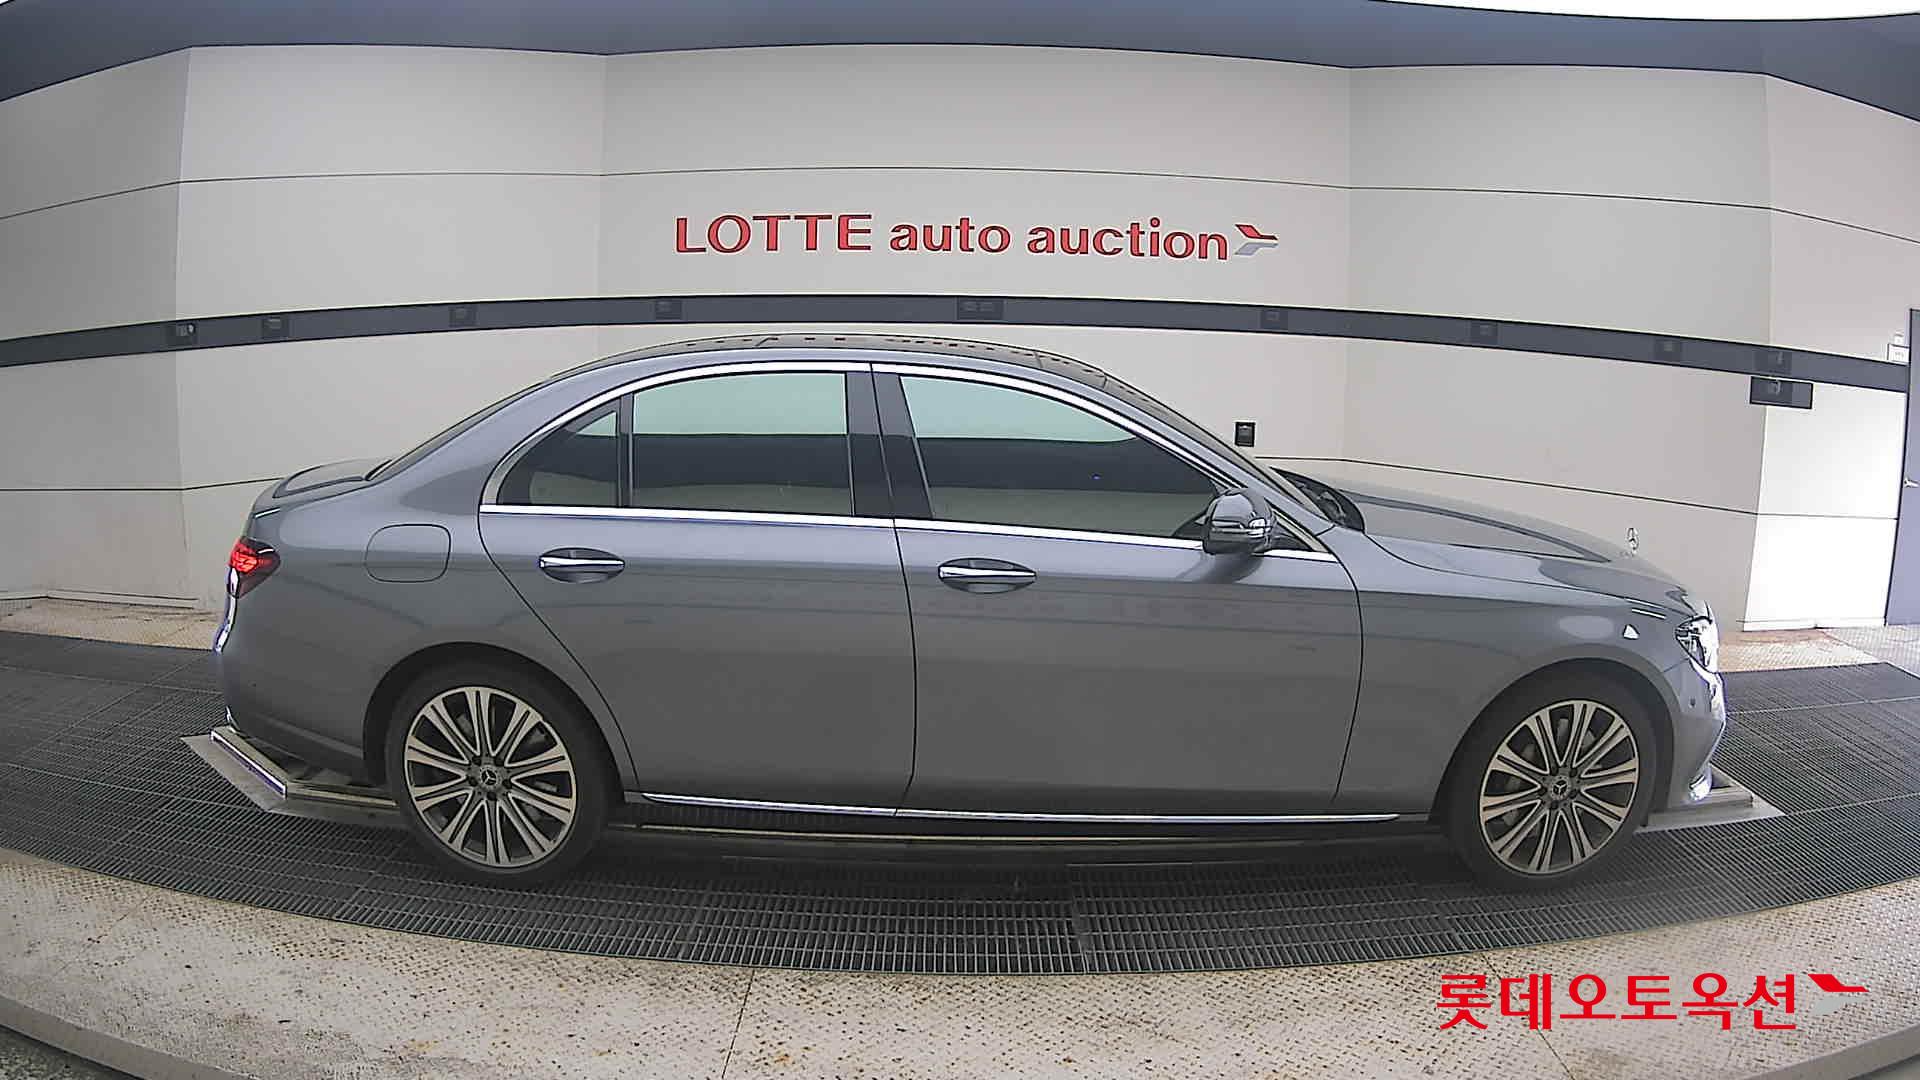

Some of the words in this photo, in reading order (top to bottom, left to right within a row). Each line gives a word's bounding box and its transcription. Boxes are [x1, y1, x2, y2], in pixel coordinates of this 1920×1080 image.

[675, 214, 872, 253] LOTTE
[889, 217, 1011, 254] auto
[1026, 217, 1229, 261] auction
